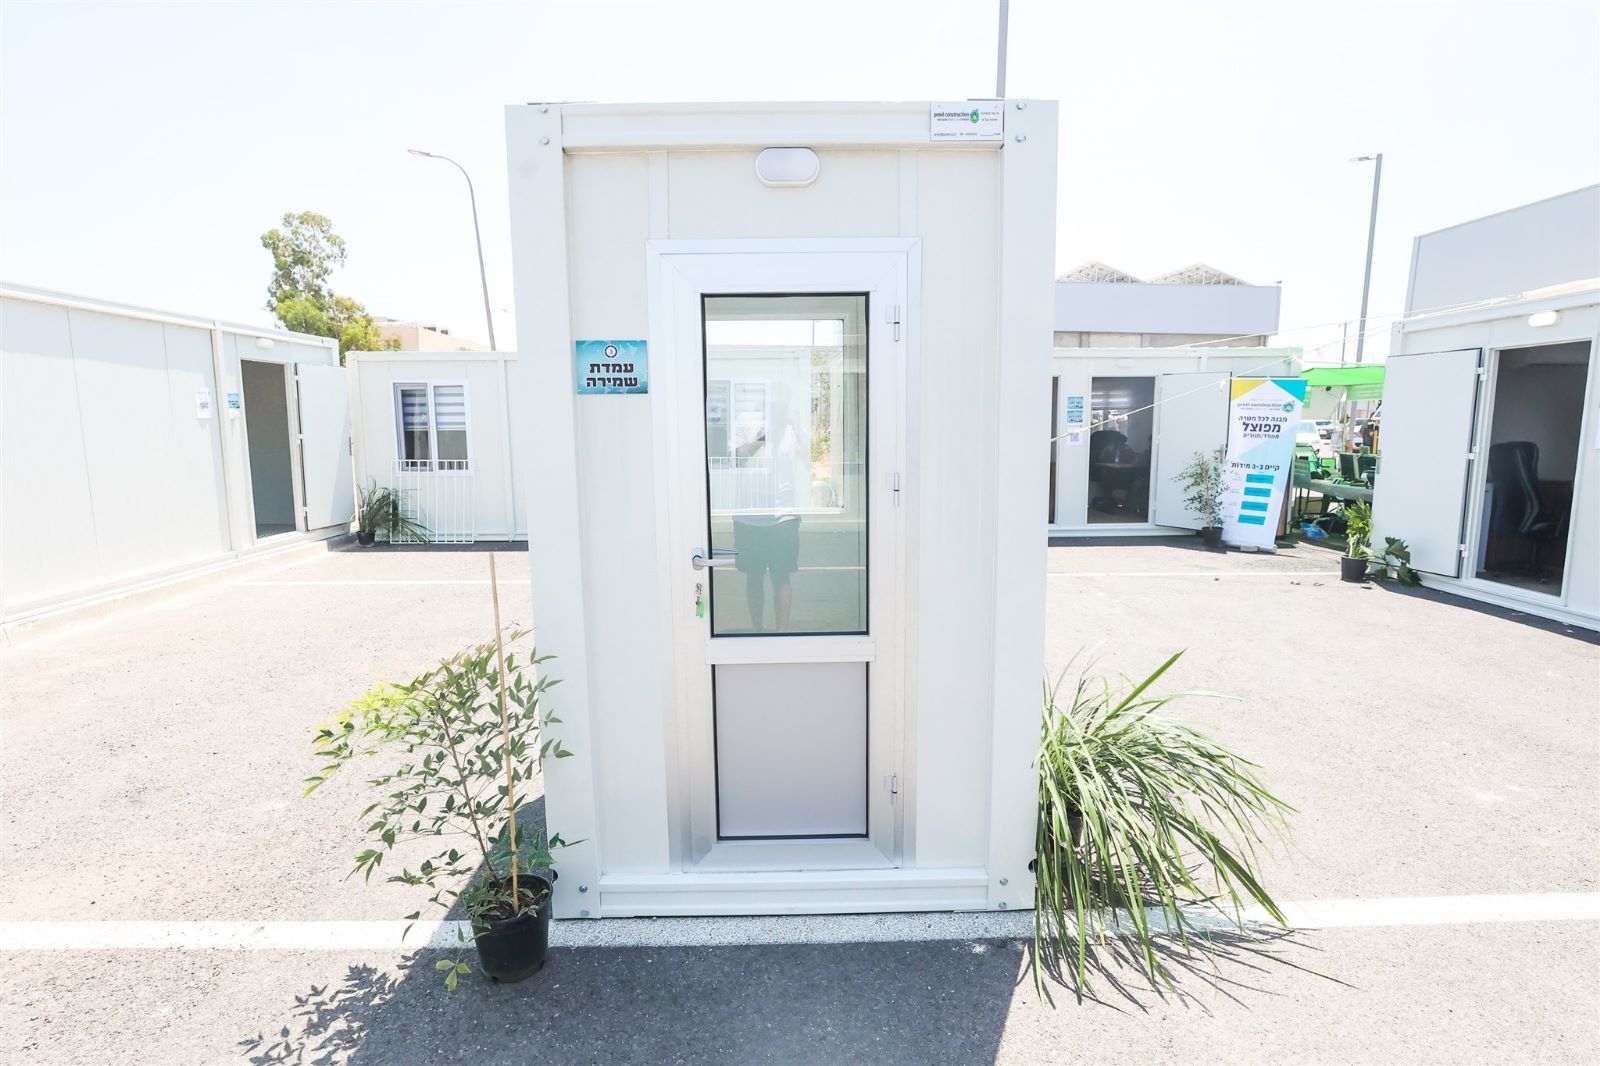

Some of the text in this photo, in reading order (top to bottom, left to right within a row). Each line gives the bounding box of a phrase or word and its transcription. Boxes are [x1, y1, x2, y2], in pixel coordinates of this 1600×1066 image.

[589, 363, 634, 374] עמדת
[586, 377, 638, 388] שמירה
[1242, 421, 1281, 433] מפוצל
